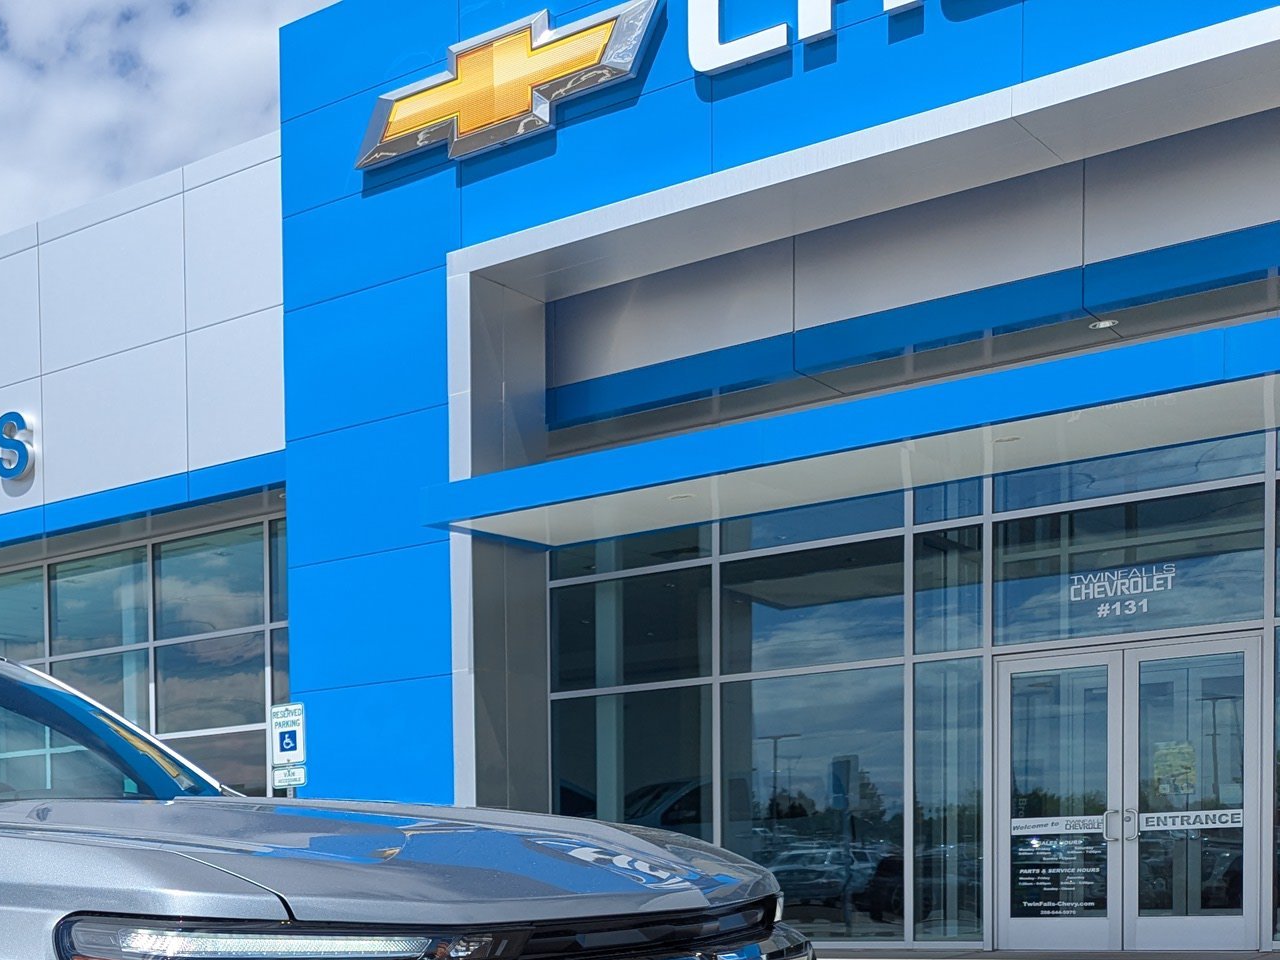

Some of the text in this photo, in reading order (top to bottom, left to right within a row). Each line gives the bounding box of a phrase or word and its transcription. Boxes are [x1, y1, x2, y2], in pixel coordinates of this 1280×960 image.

[1070, 563, 1176, 585] TWINFALLS
[1070, 573, 1176, 602] CHEVROLET
[1097, 598, 1148, 618] #131
[272, 709, 303, 719] RESERVED
[274, 719, 300, 729] PARKING
[1012, 823, 1049, 831] Welcome
[1145, 813, 1241, 827] ENTRANCE
